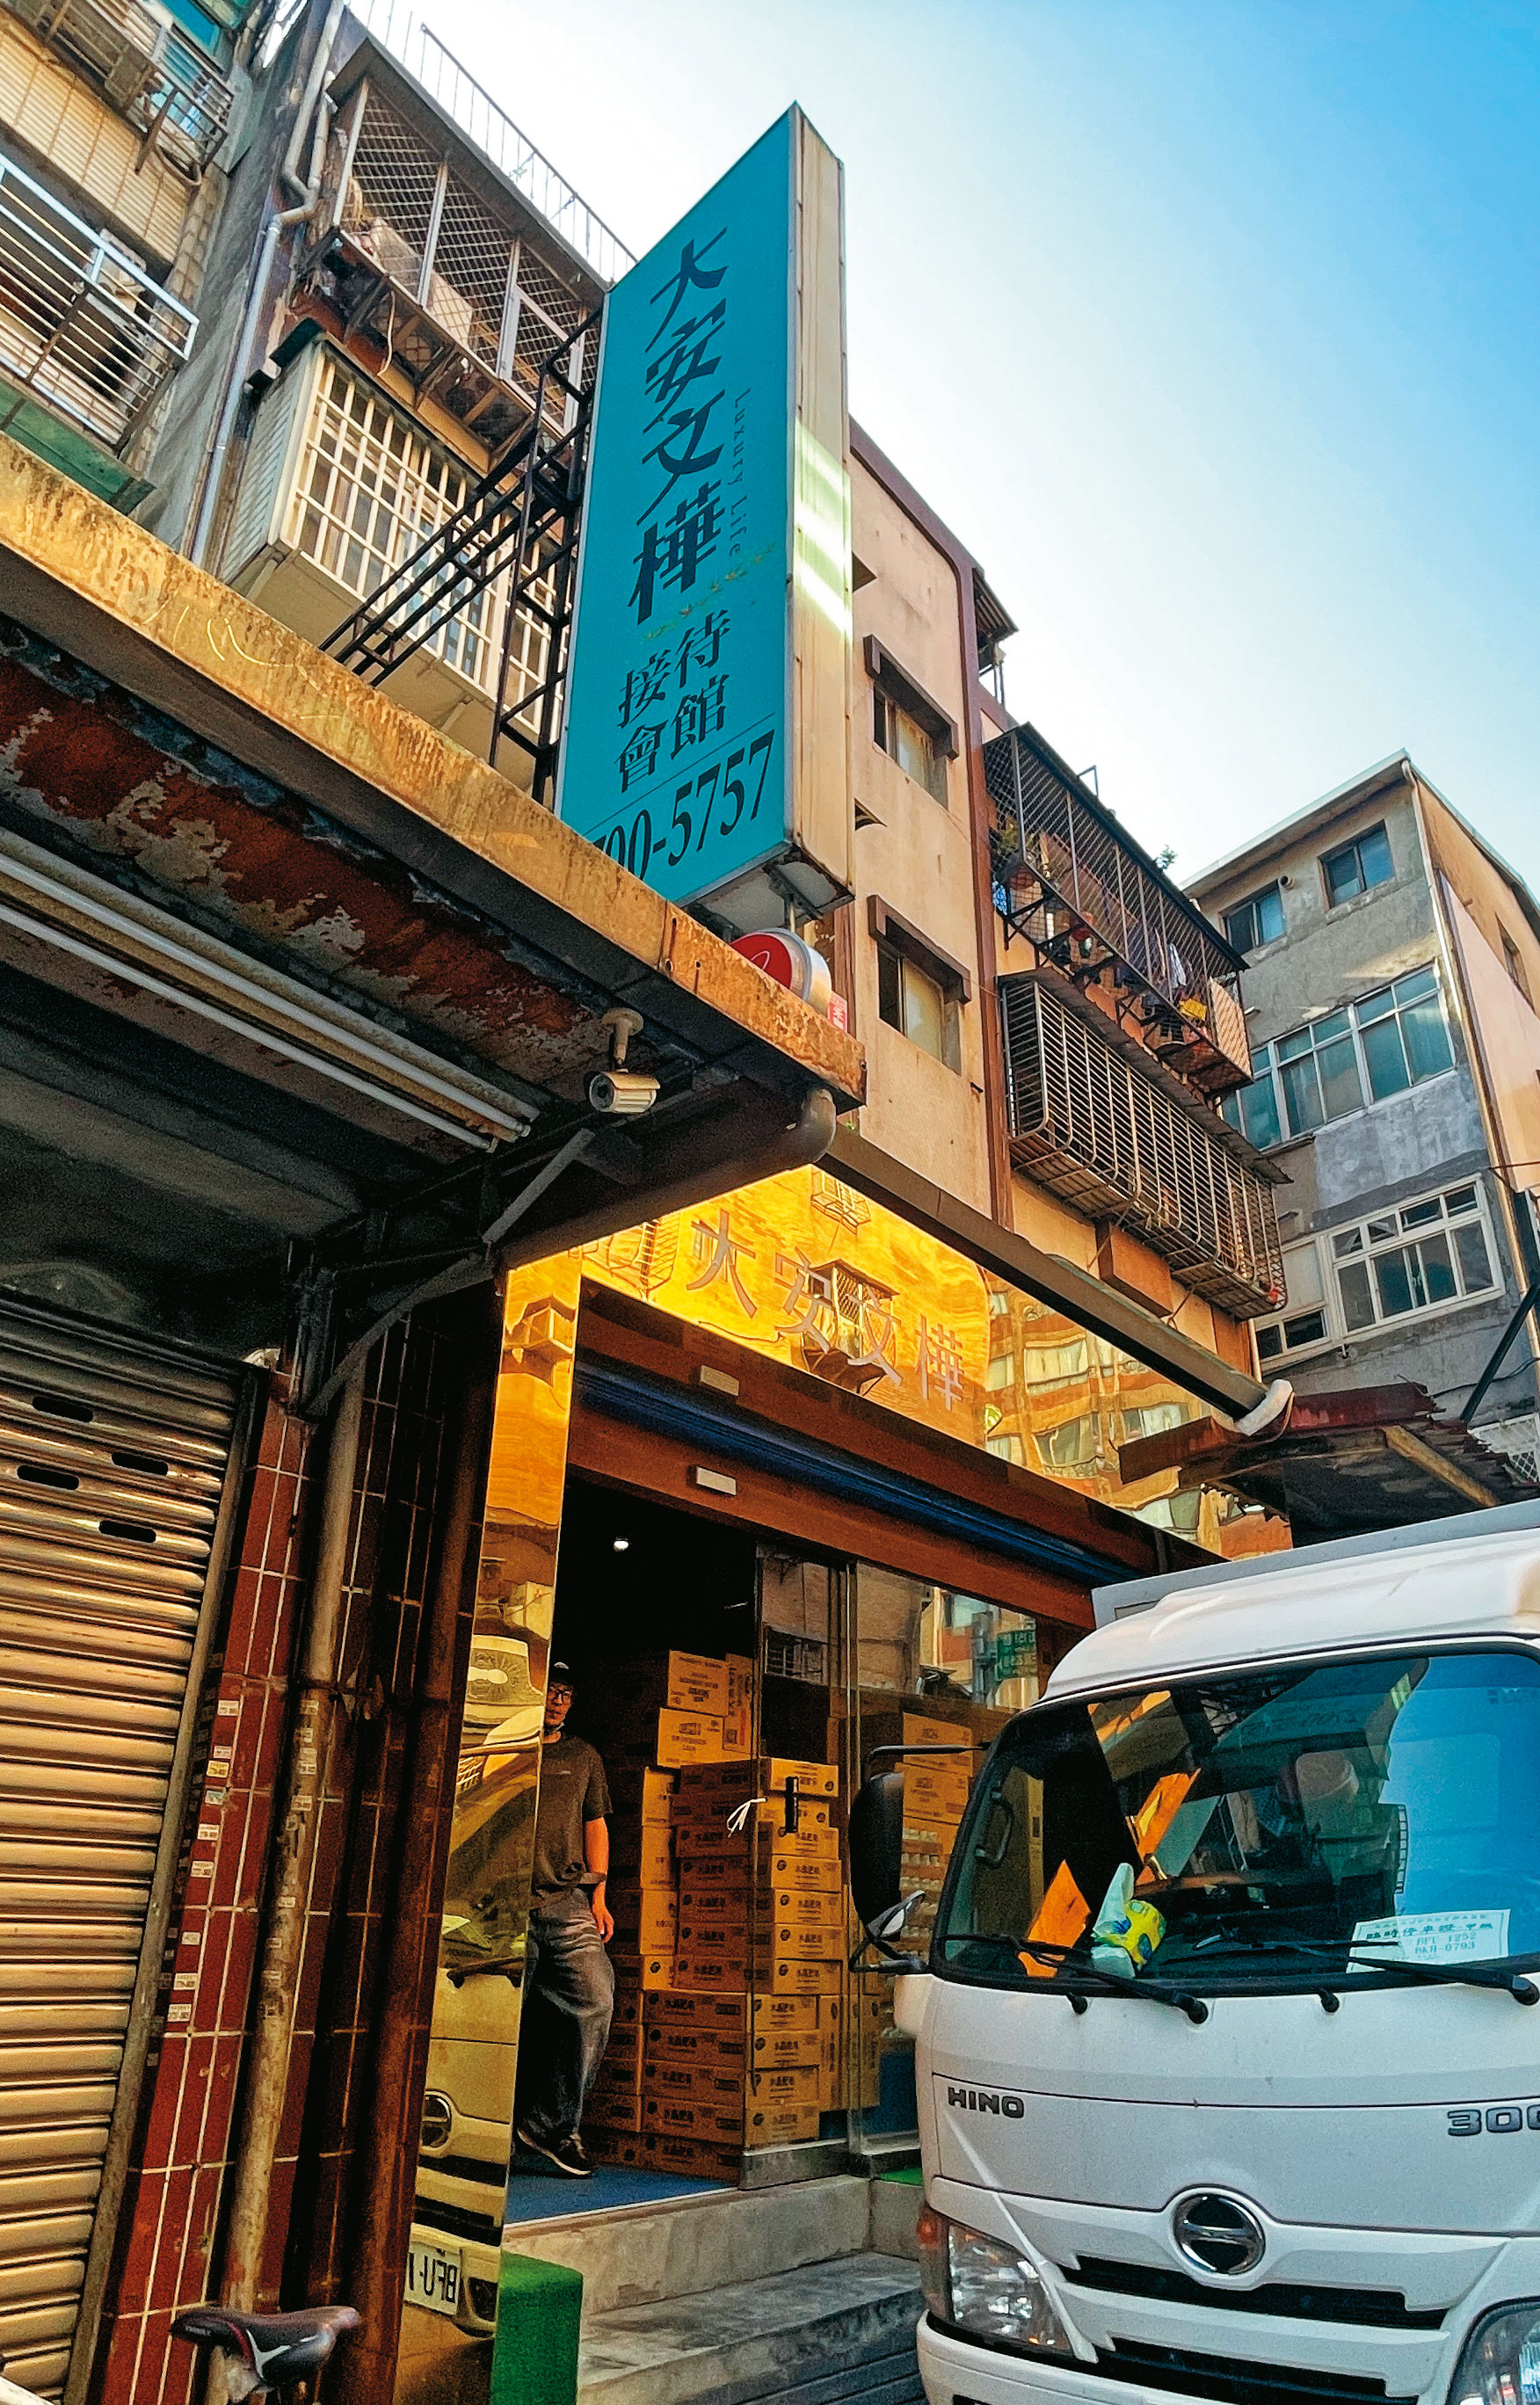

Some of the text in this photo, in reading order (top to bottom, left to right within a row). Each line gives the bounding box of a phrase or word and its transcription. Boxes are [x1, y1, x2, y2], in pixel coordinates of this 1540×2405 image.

[628, 227, 729, 624] 大安文樺
[728, 388, 751, 557] Luxury Life
[615, 674, 729, 793] 會館
[616, 609, 731, 728] 接待
[686, 1208, 965, 1412] 大安文樺
[948, 2086, 1024, 2119] HINO
